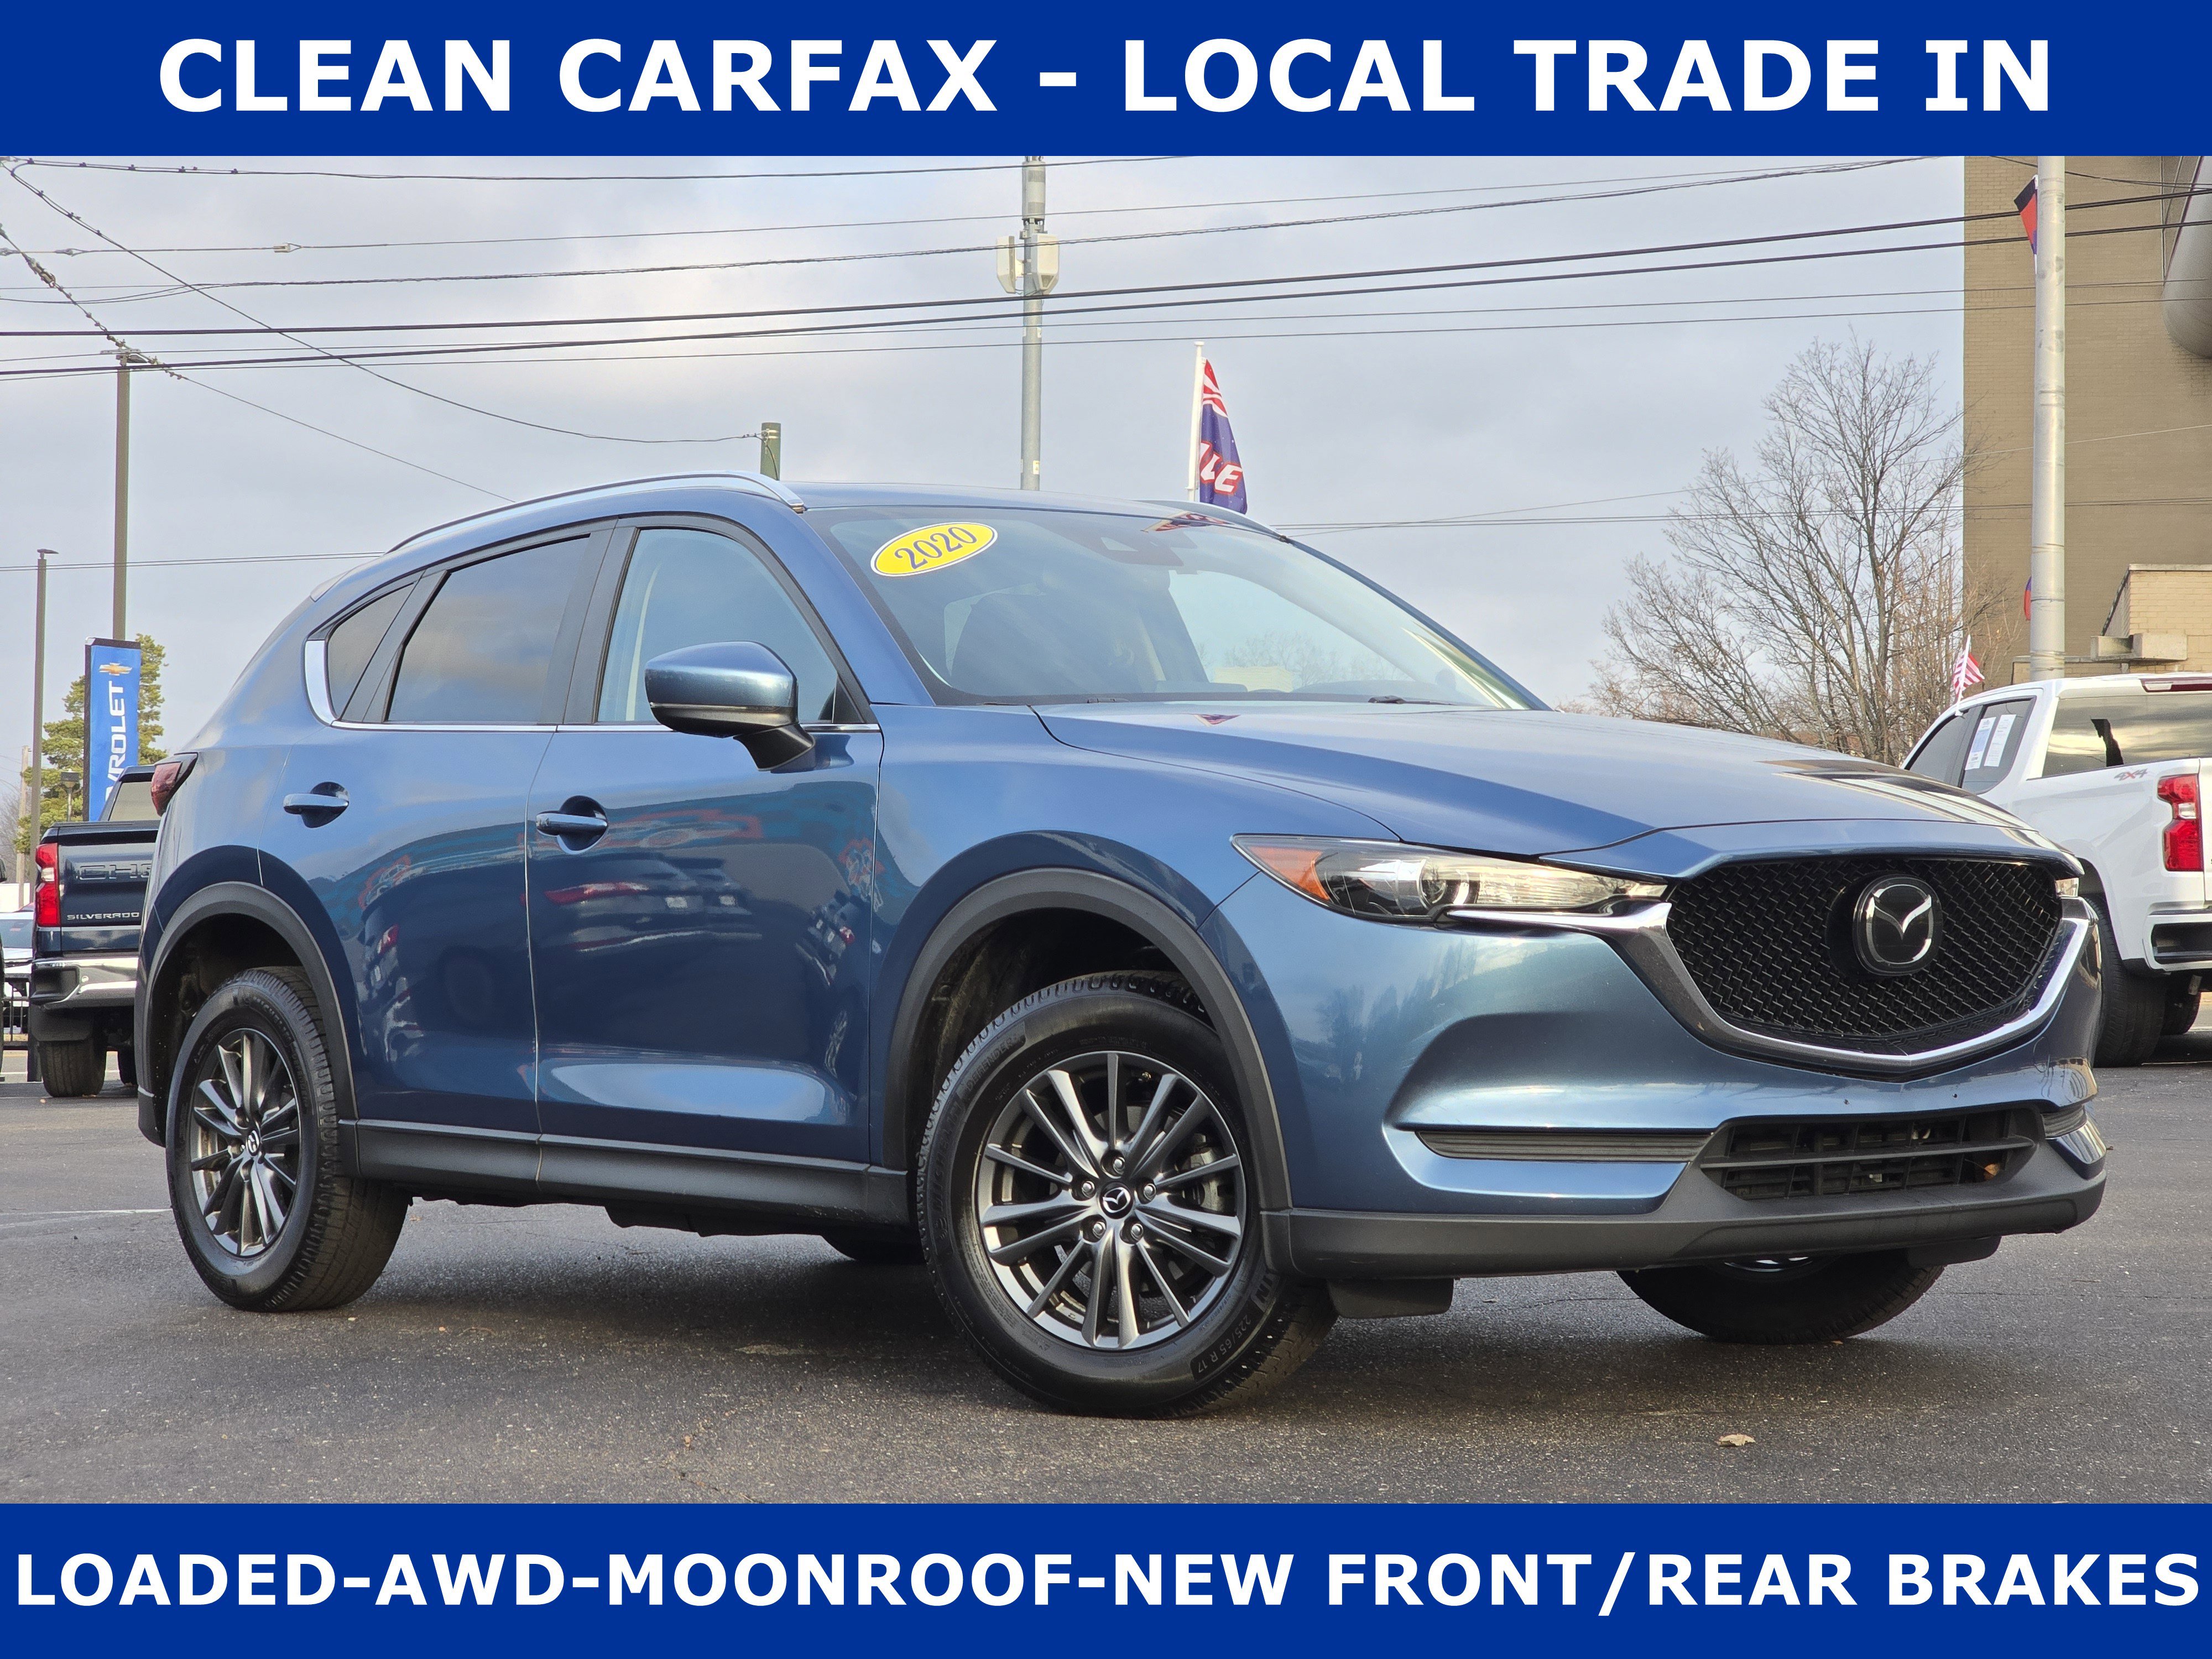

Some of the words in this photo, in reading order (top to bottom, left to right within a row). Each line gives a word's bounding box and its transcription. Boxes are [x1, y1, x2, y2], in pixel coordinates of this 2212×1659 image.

[894, 527, 977, 569] 2020
[67, 912, 139, 920] SILVERADO
[1219, 1315, 1251, 1355] 225/65
